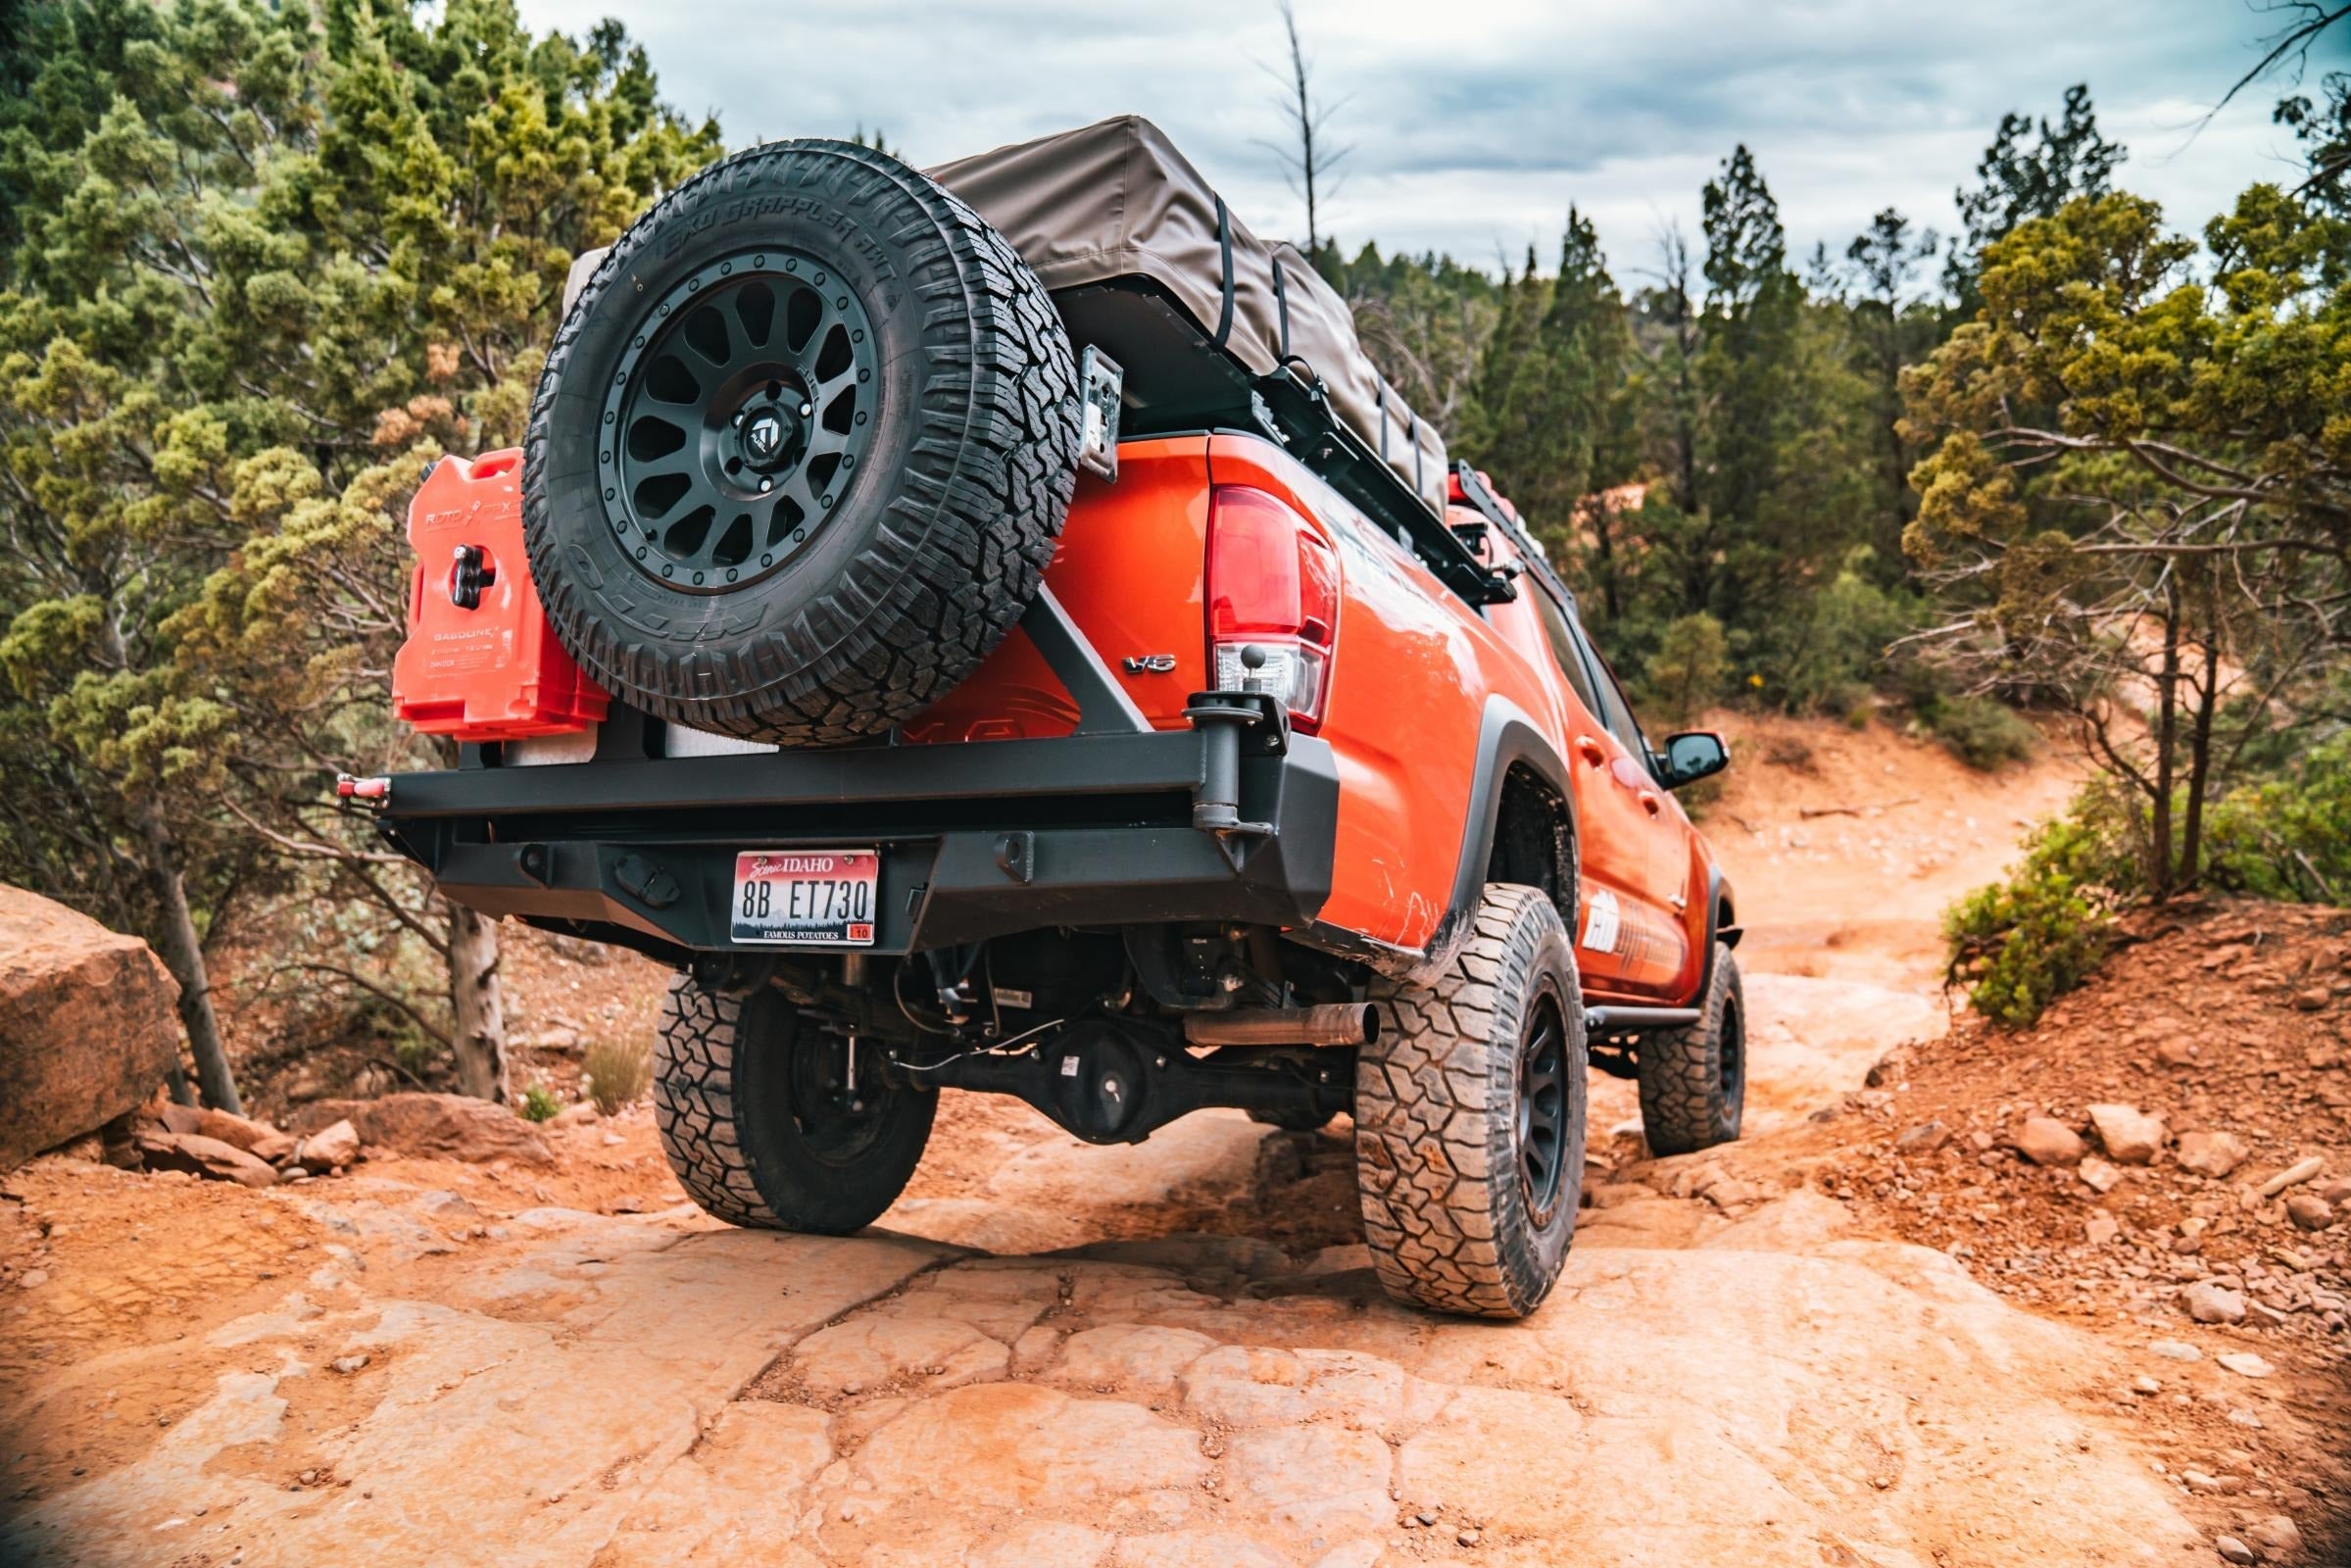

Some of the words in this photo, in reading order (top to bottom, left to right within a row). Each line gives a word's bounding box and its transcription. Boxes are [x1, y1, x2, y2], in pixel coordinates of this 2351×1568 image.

[720, 196, 859, 243] GRAPPLER
[750, 432, 767, 454] FUEL
[1121, 654, 1177, 674] V6
[749, 860, 784, 879] Scenic
[783, 858, 834, 873] IDAHO
[742, 880, 771, 919] 8B
[789, 880, 868, 920] ET730
[763, 930, 796, 940] FAMOUS
[797, 931, 839, 941] POTATOES
